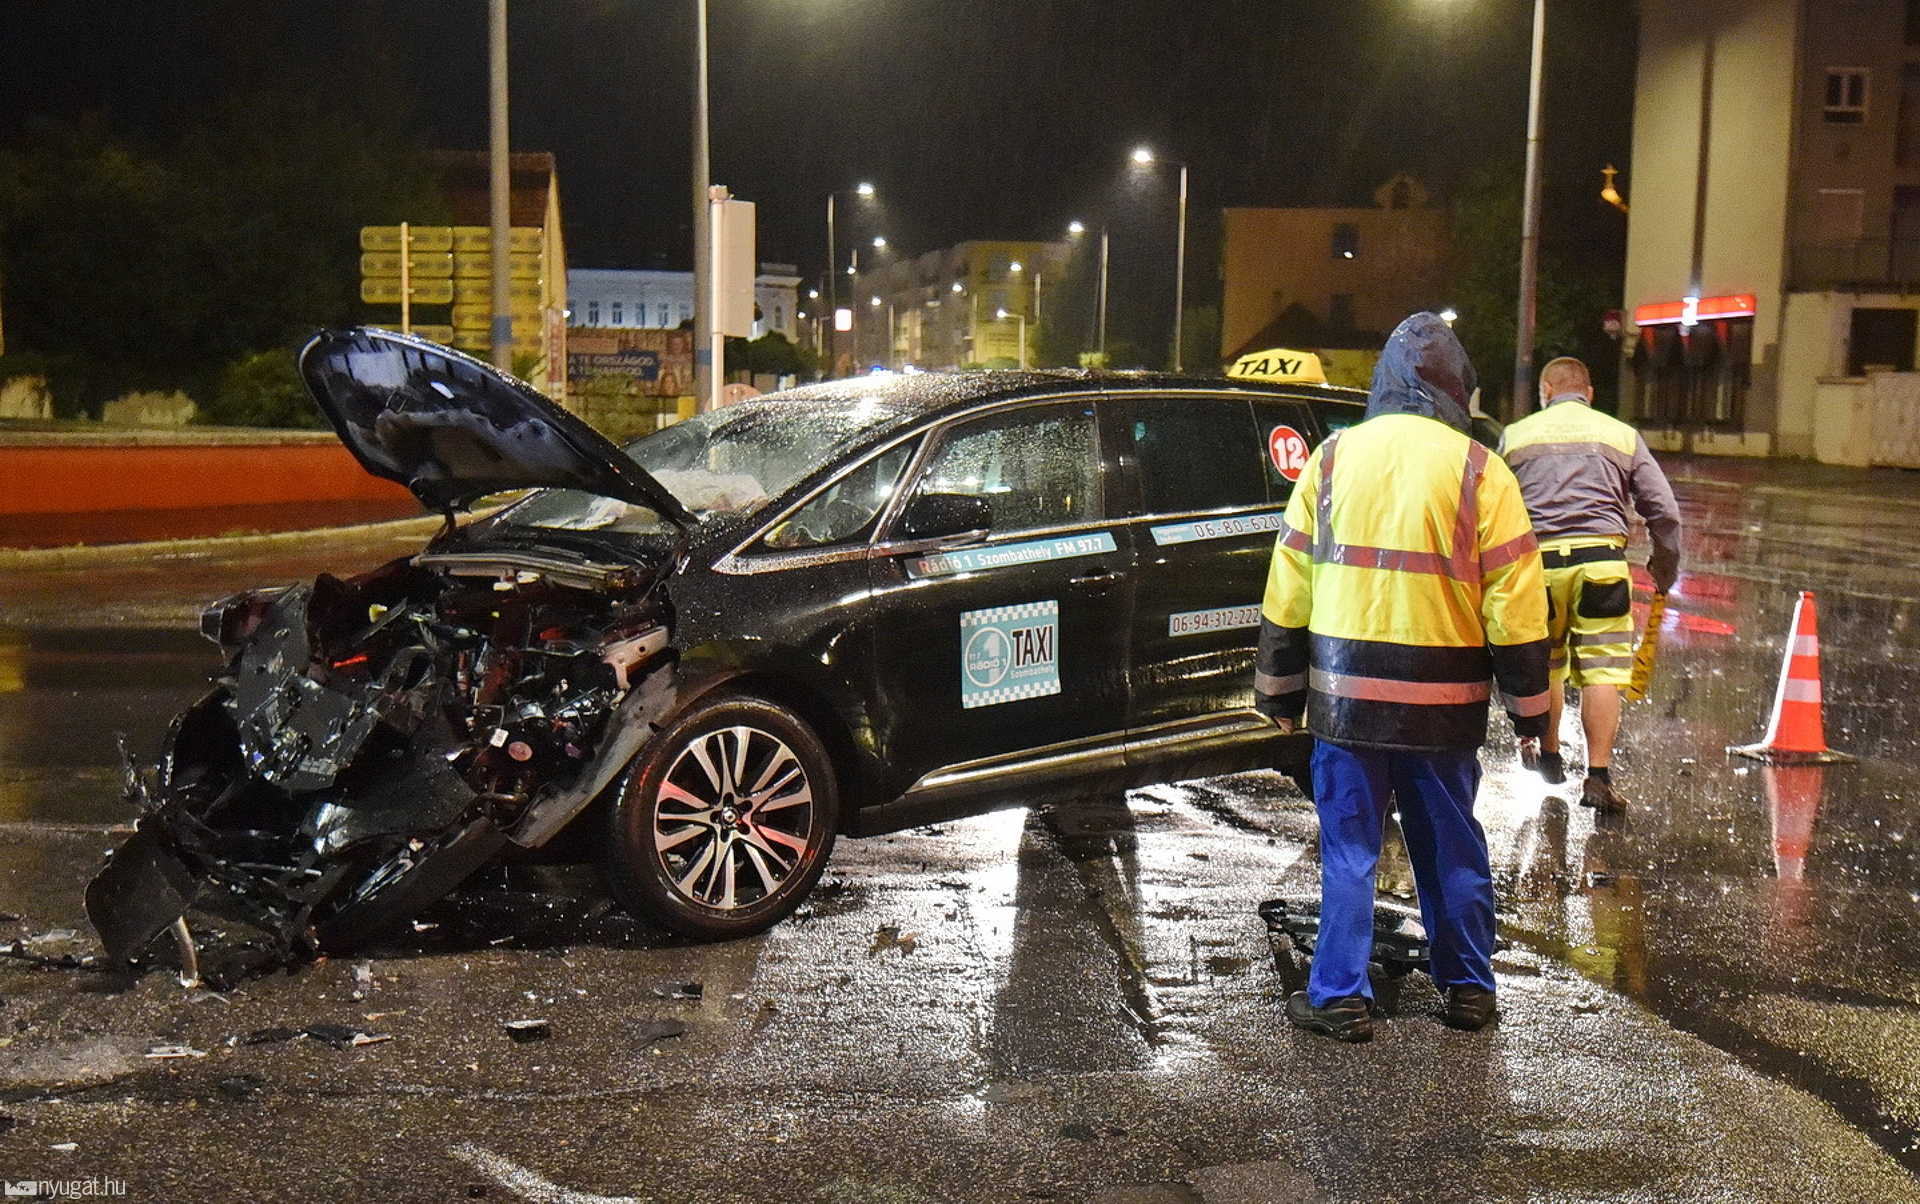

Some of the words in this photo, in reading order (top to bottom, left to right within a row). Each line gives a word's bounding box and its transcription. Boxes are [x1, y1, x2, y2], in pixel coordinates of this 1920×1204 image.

[1239, 358, 1303, 376] TAXI
[1273, 436, 1305, 471] 12
[1194, 515, 1281, 538] 06-80-620
[918, 556, 963, 574] Rádió
[964, 555, 974, 568] 1
[977, 545, 1052, 567] Szombathely
[1055, 541, 1077, 556] FM
[1079, 537, 1103, 553] 97.7
[1172, 607, 1260, 633] 06-94-312-222
[1011, 624, 1054, 668] TAXI
